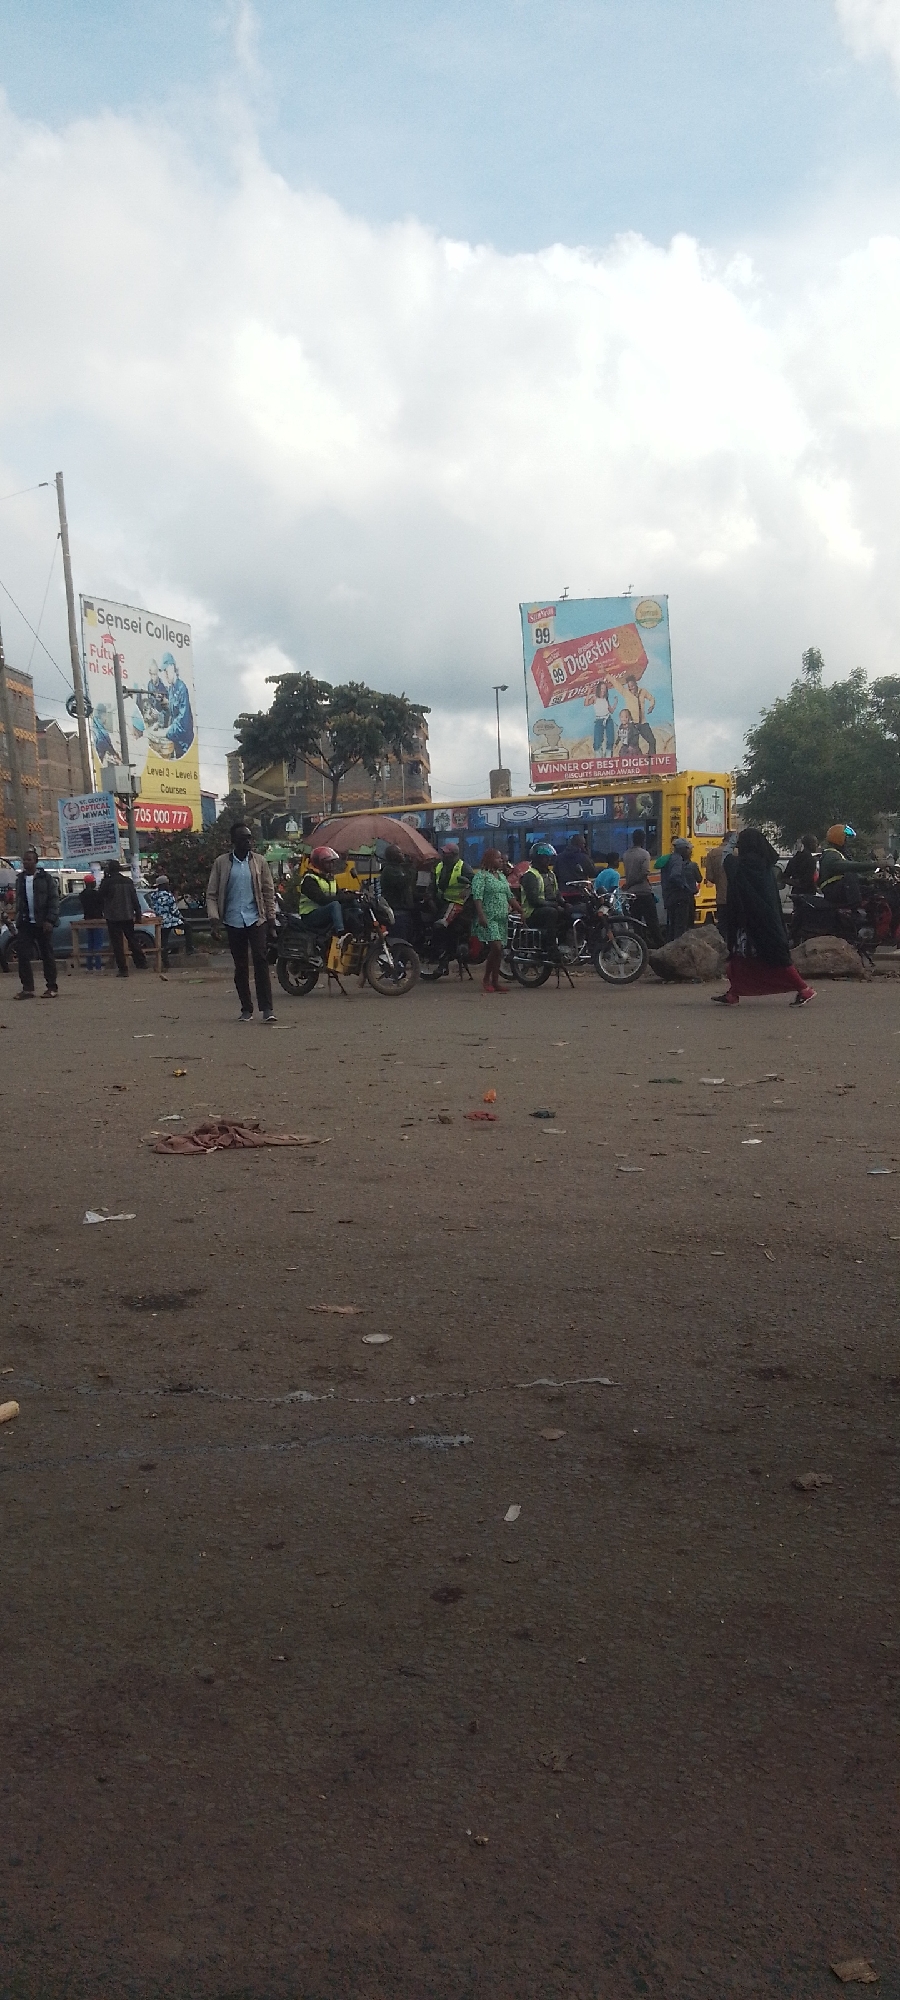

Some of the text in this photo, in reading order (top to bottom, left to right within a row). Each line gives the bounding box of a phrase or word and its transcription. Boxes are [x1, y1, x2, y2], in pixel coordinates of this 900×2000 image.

[97, 608, 190, 648] Sensei College
[535, 627, 550, 644] 99
[89, 643, 125, 664] Futue
[564, 634, 620, 675] Digestive
[89, 659, 99, 673] ni
[552, 668, 565, 683] 99
[147, 765, 165, 778] Level
[176, 769, 193, 780] Level
[537, 756, 671, 774] WINNER OF BEST DIGESTIVE
[564, 768, 640, 779] BISCUITS BRAND AWARD
[160, 784, 187, 795] Courses
[80, 803, 110, 812] OPTICAL
[82, 809, 110, 819] MIWANI
[479, 797, 607, 828] TOSH
[153, 809, 170, 824] 000
[172, 811, 188, 825] 777
